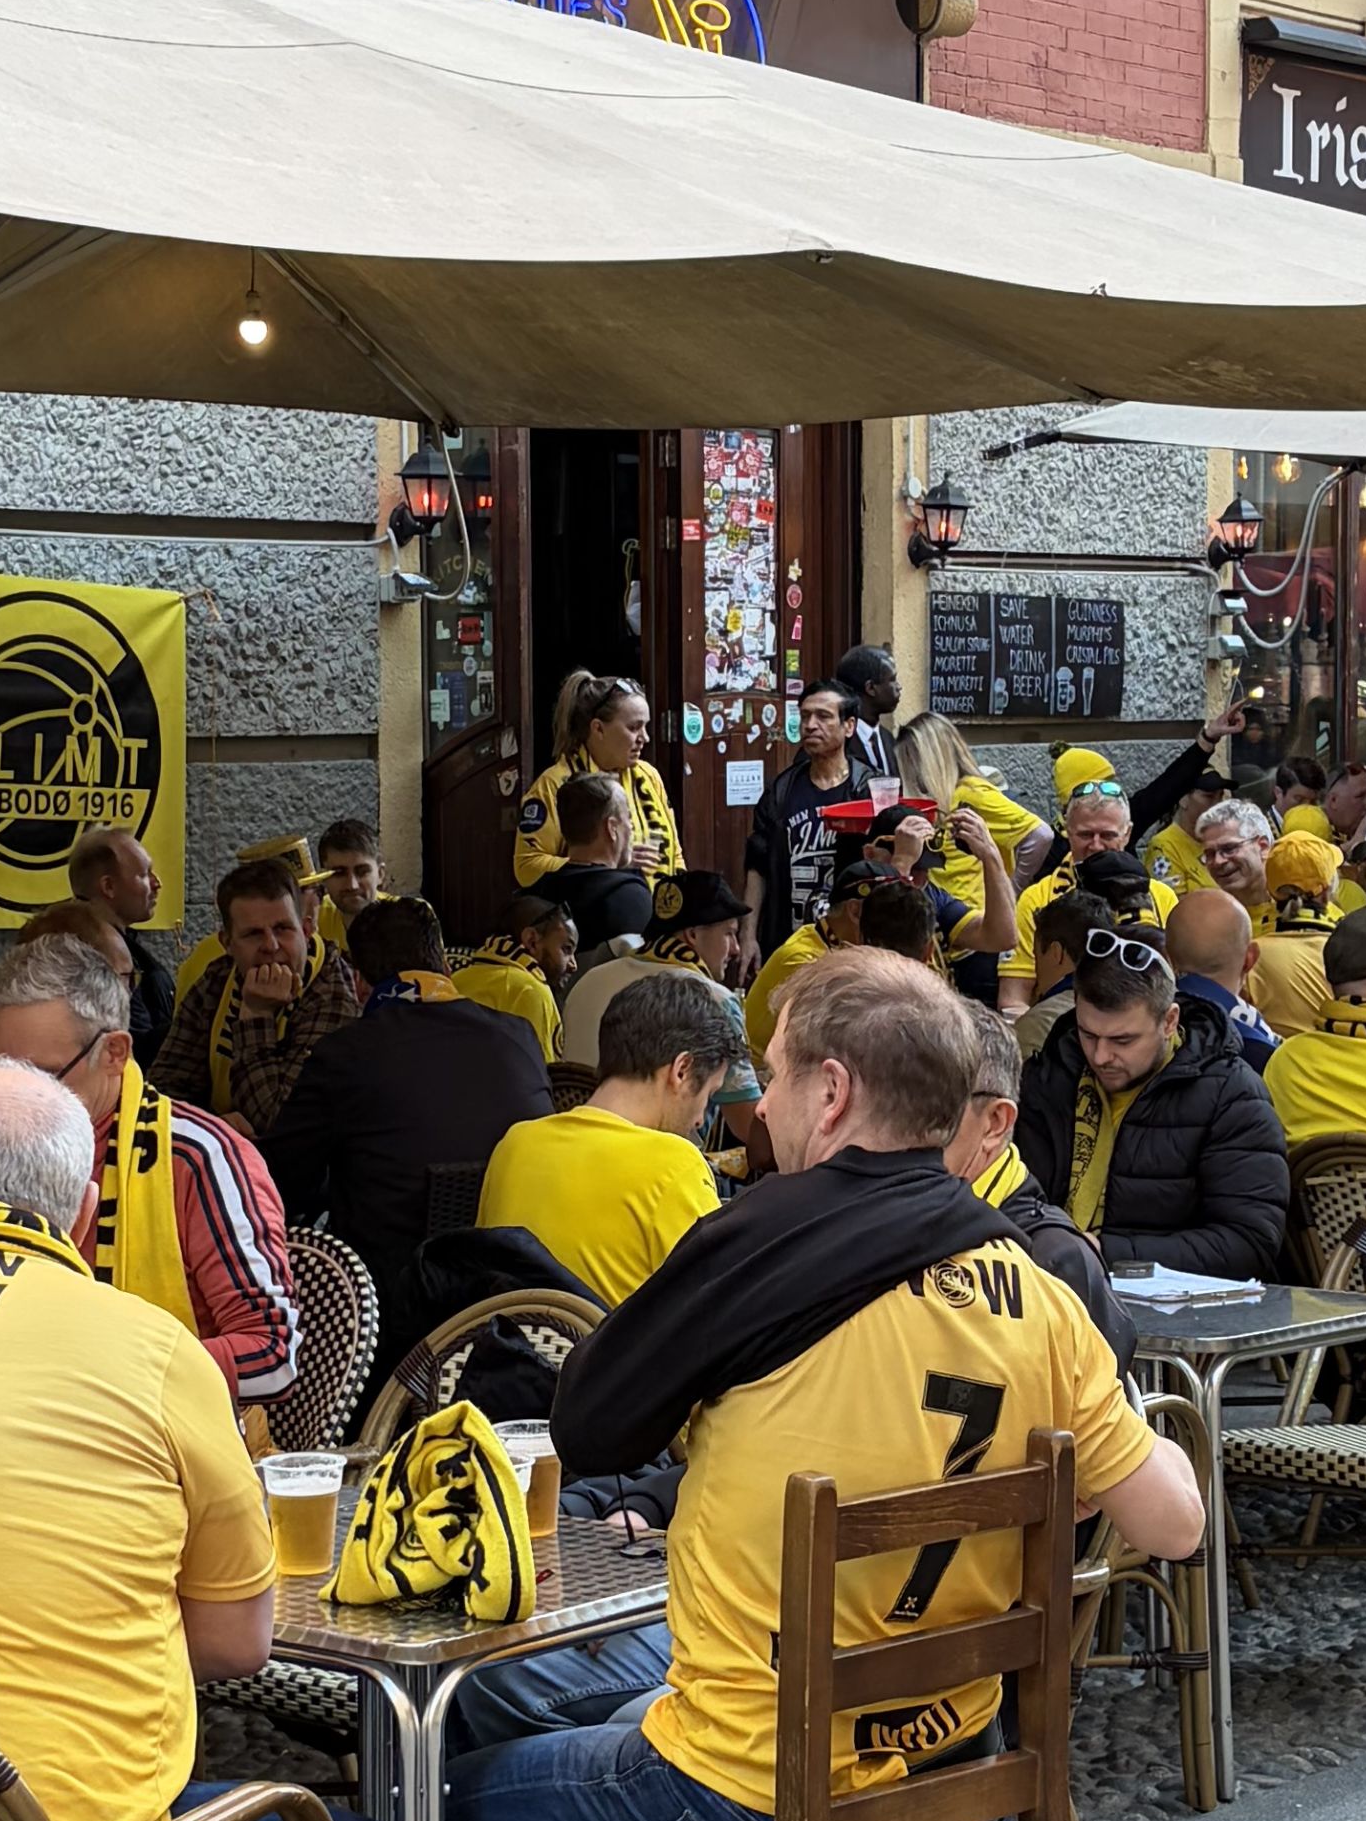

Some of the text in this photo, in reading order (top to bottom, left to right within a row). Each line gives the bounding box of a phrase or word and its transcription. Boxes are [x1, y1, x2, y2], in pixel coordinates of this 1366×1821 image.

[932, 592, 980, 612] HEINEKEN
[999, 598, 1030, 620] SAVE
[1067, 599, 1118, 623] GUINNESS
[933, 614, 978, 632] ICHNUSA
[998, 624, 1035, 646] WATER
[933, 655, 977, 672] MORETTI
[1009, 649, 1047, 673] DRINK
[947, 674, 984, 692] MORETTI
[78, 792, 134, 818] 1916
[884, 1370, 1007, 1624] 7
